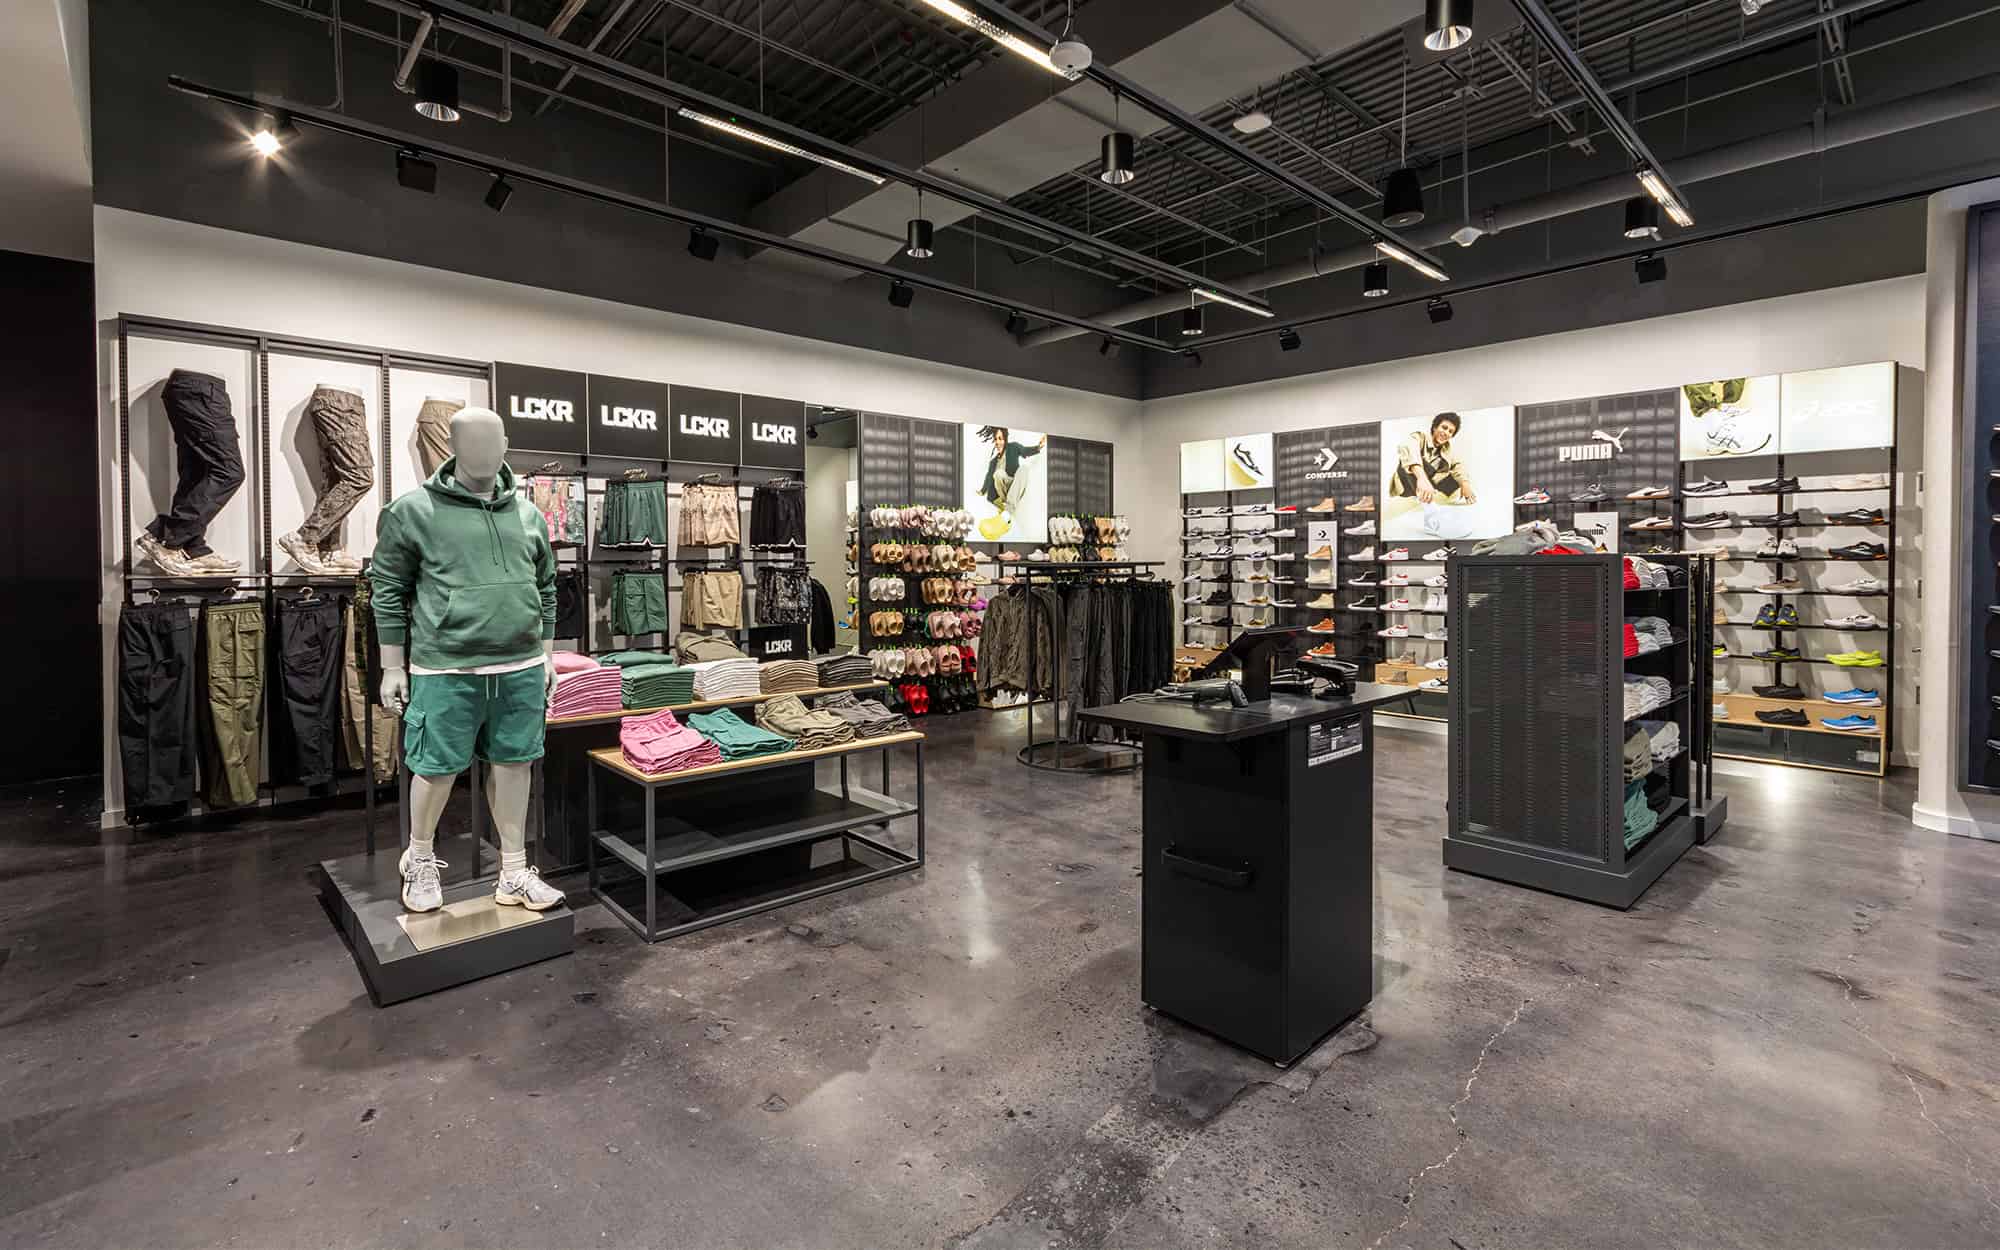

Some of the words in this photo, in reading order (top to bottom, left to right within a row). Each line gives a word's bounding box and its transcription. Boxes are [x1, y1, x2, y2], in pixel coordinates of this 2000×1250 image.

[510, 395, 574, 423] LCKR
[601, 404, 657, 430] LCKR
[680, 414, 730, 438] LCKR
[752, 422, 797, 445] LCKR
[1559, 443, 1612, 462] PUMA
[1305, 471, 1348, 480] CONVERSE
[765, 639, 792, 654] LCKR
